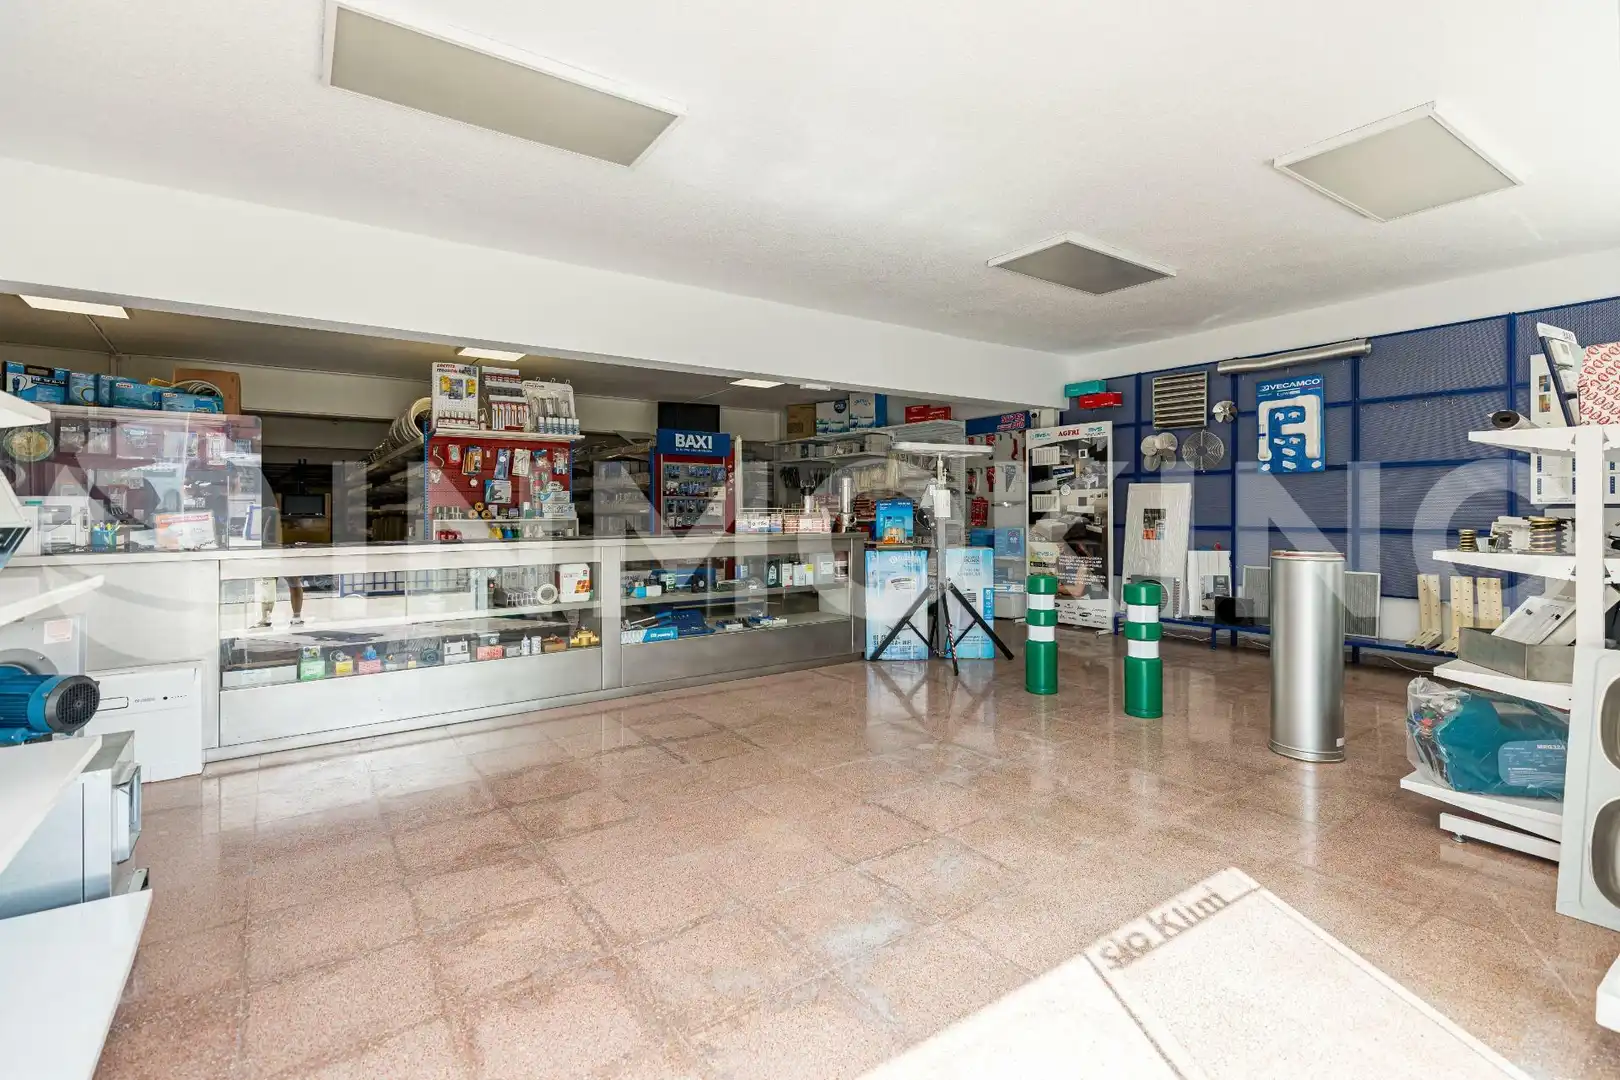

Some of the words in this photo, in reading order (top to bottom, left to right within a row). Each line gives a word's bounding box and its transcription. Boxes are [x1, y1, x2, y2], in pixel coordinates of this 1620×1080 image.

[1269, 378, 1321, 390] VECAMCO
[1058, 429, 1080, 437] AGFRI
[675, 433, 713, 450] BAXI
